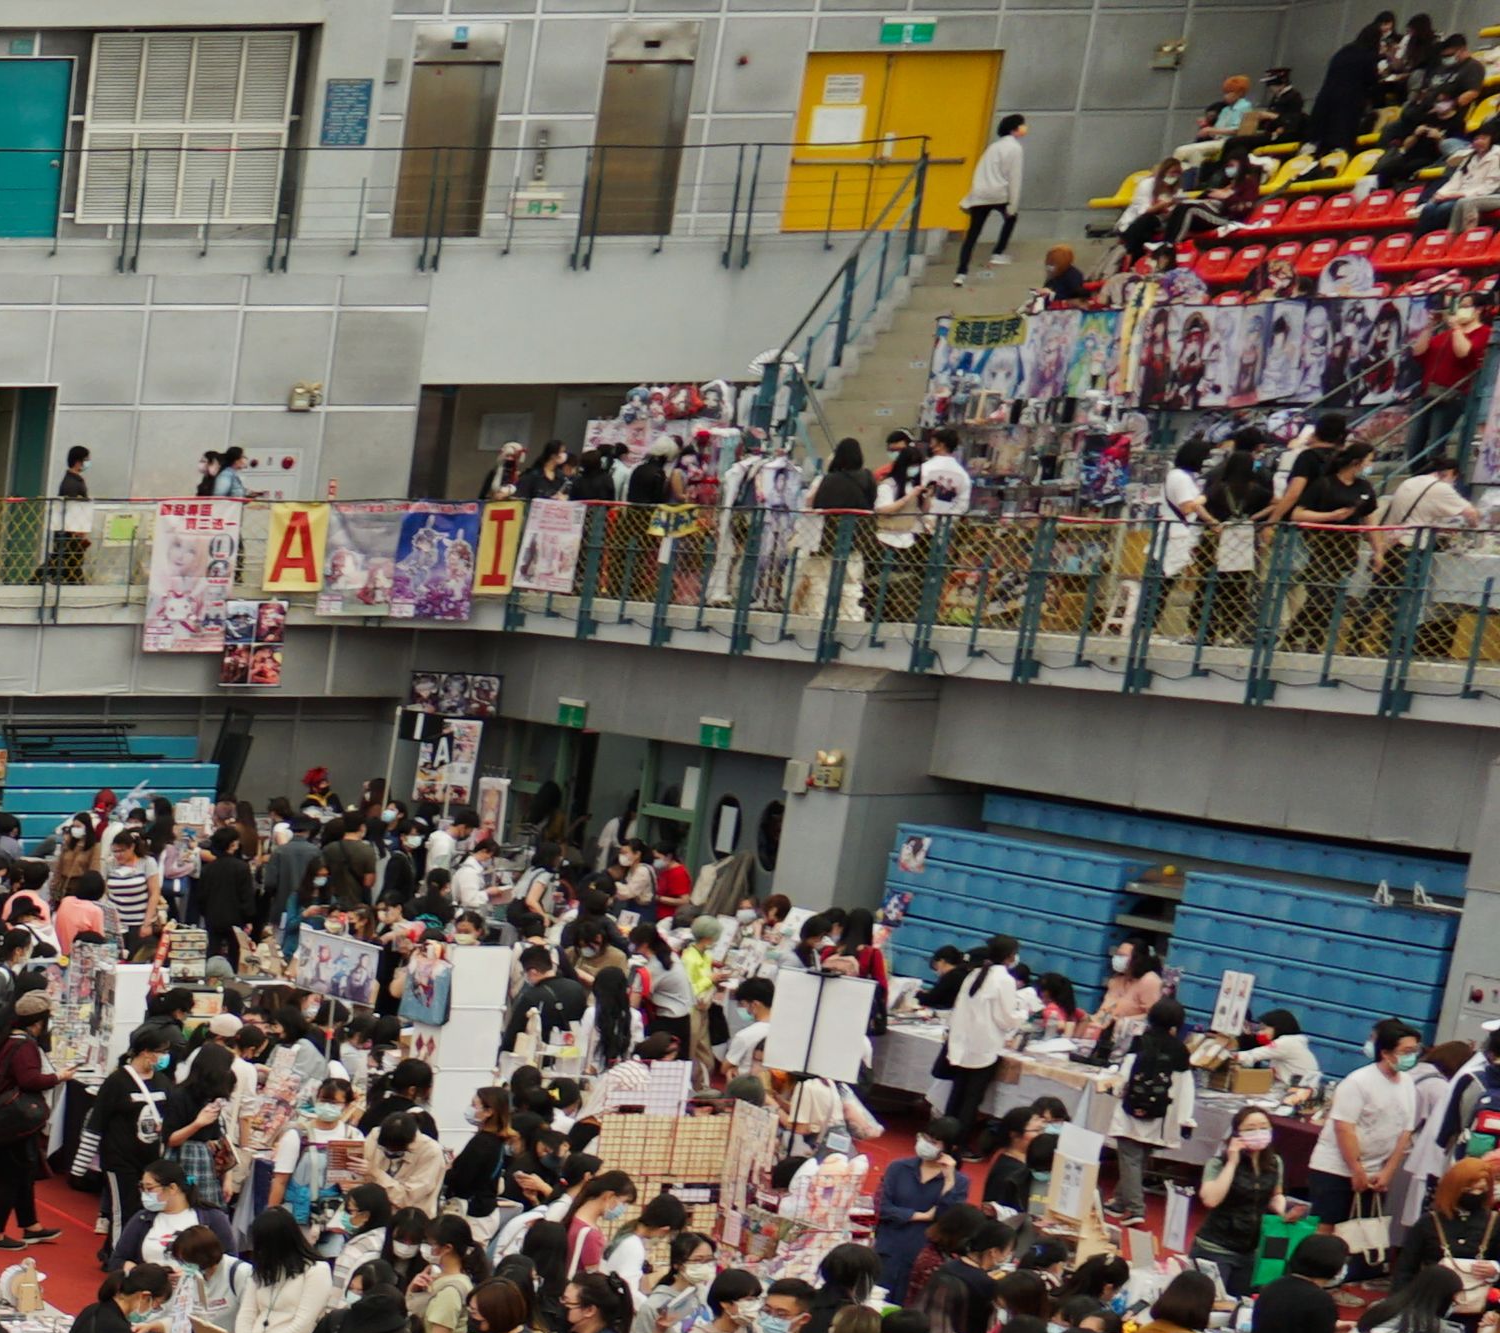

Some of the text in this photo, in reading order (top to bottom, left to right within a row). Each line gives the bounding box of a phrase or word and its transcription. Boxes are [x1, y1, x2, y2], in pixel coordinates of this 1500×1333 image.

[268, 511, 317, 583] A
[480, 508, 515, 586] I
[432, 735, 451, 768] A
